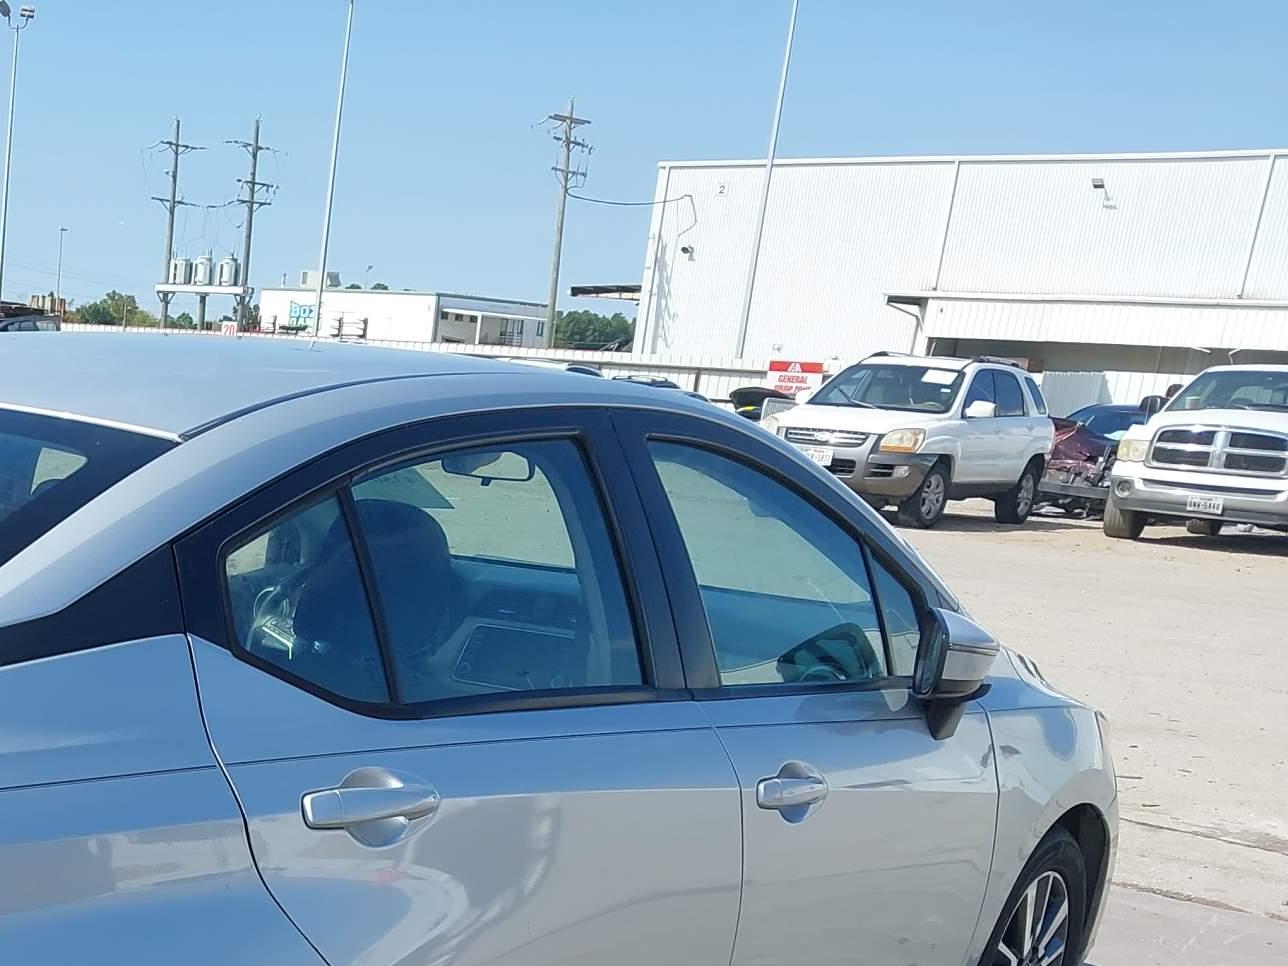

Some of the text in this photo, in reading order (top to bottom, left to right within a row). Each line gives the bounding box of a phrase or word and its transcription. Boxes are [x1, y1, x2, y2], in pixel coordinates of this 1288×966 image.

[718, 184, 726, 194] 2
[223, 323, 235, 337] 20
[778, 374, 808, 384] GENERAL
